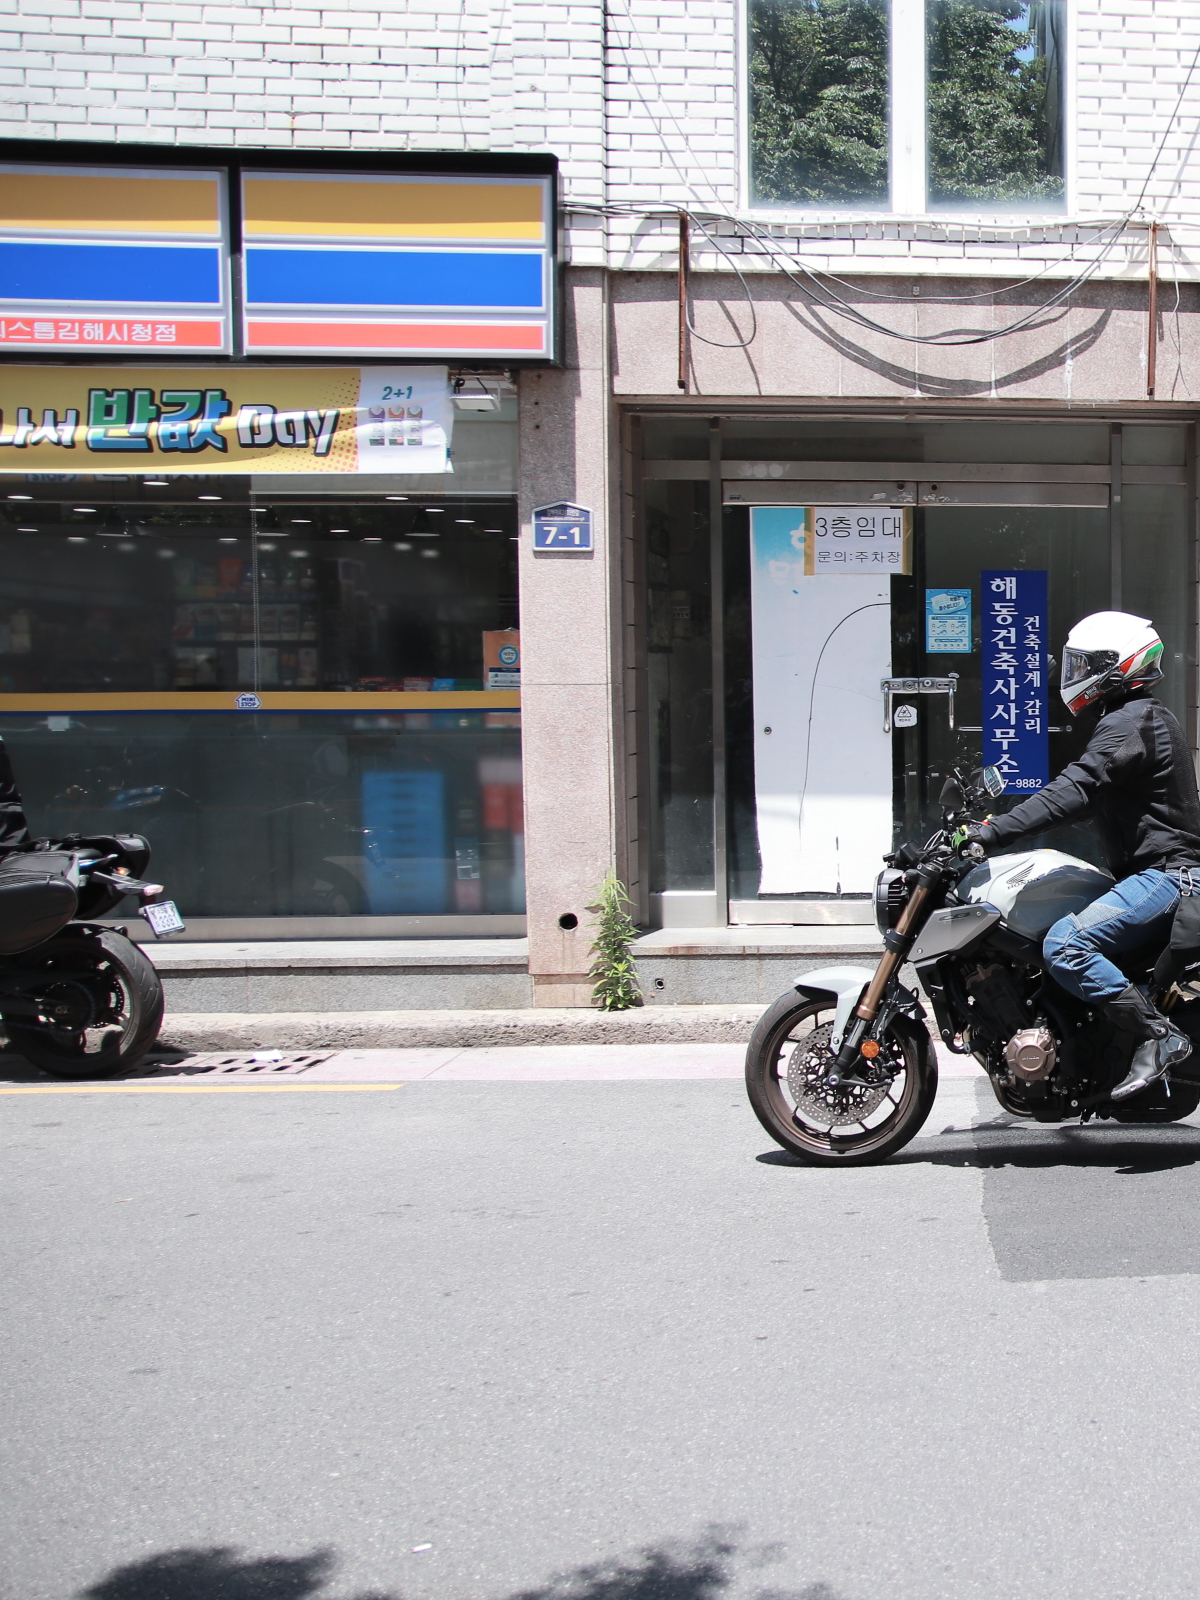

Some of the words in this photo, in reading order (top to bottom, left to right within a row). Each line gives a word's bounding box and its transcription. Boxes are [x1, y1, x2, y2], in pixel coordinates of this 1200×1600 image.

[382, 386, 413, 400] 2+1
[86, 388, 232, 453] 반값
[236, 404, 341, 457] Day
[543, 527, 580, 545] 7-1
[815, 516, 901, 538] 3층임대
[817, 551, 901, 563] 문의:주차장
[989, 576, 1020, 773] 해동건축사사무소
[1023, 615, 1042, 734] 건축설계·감리
